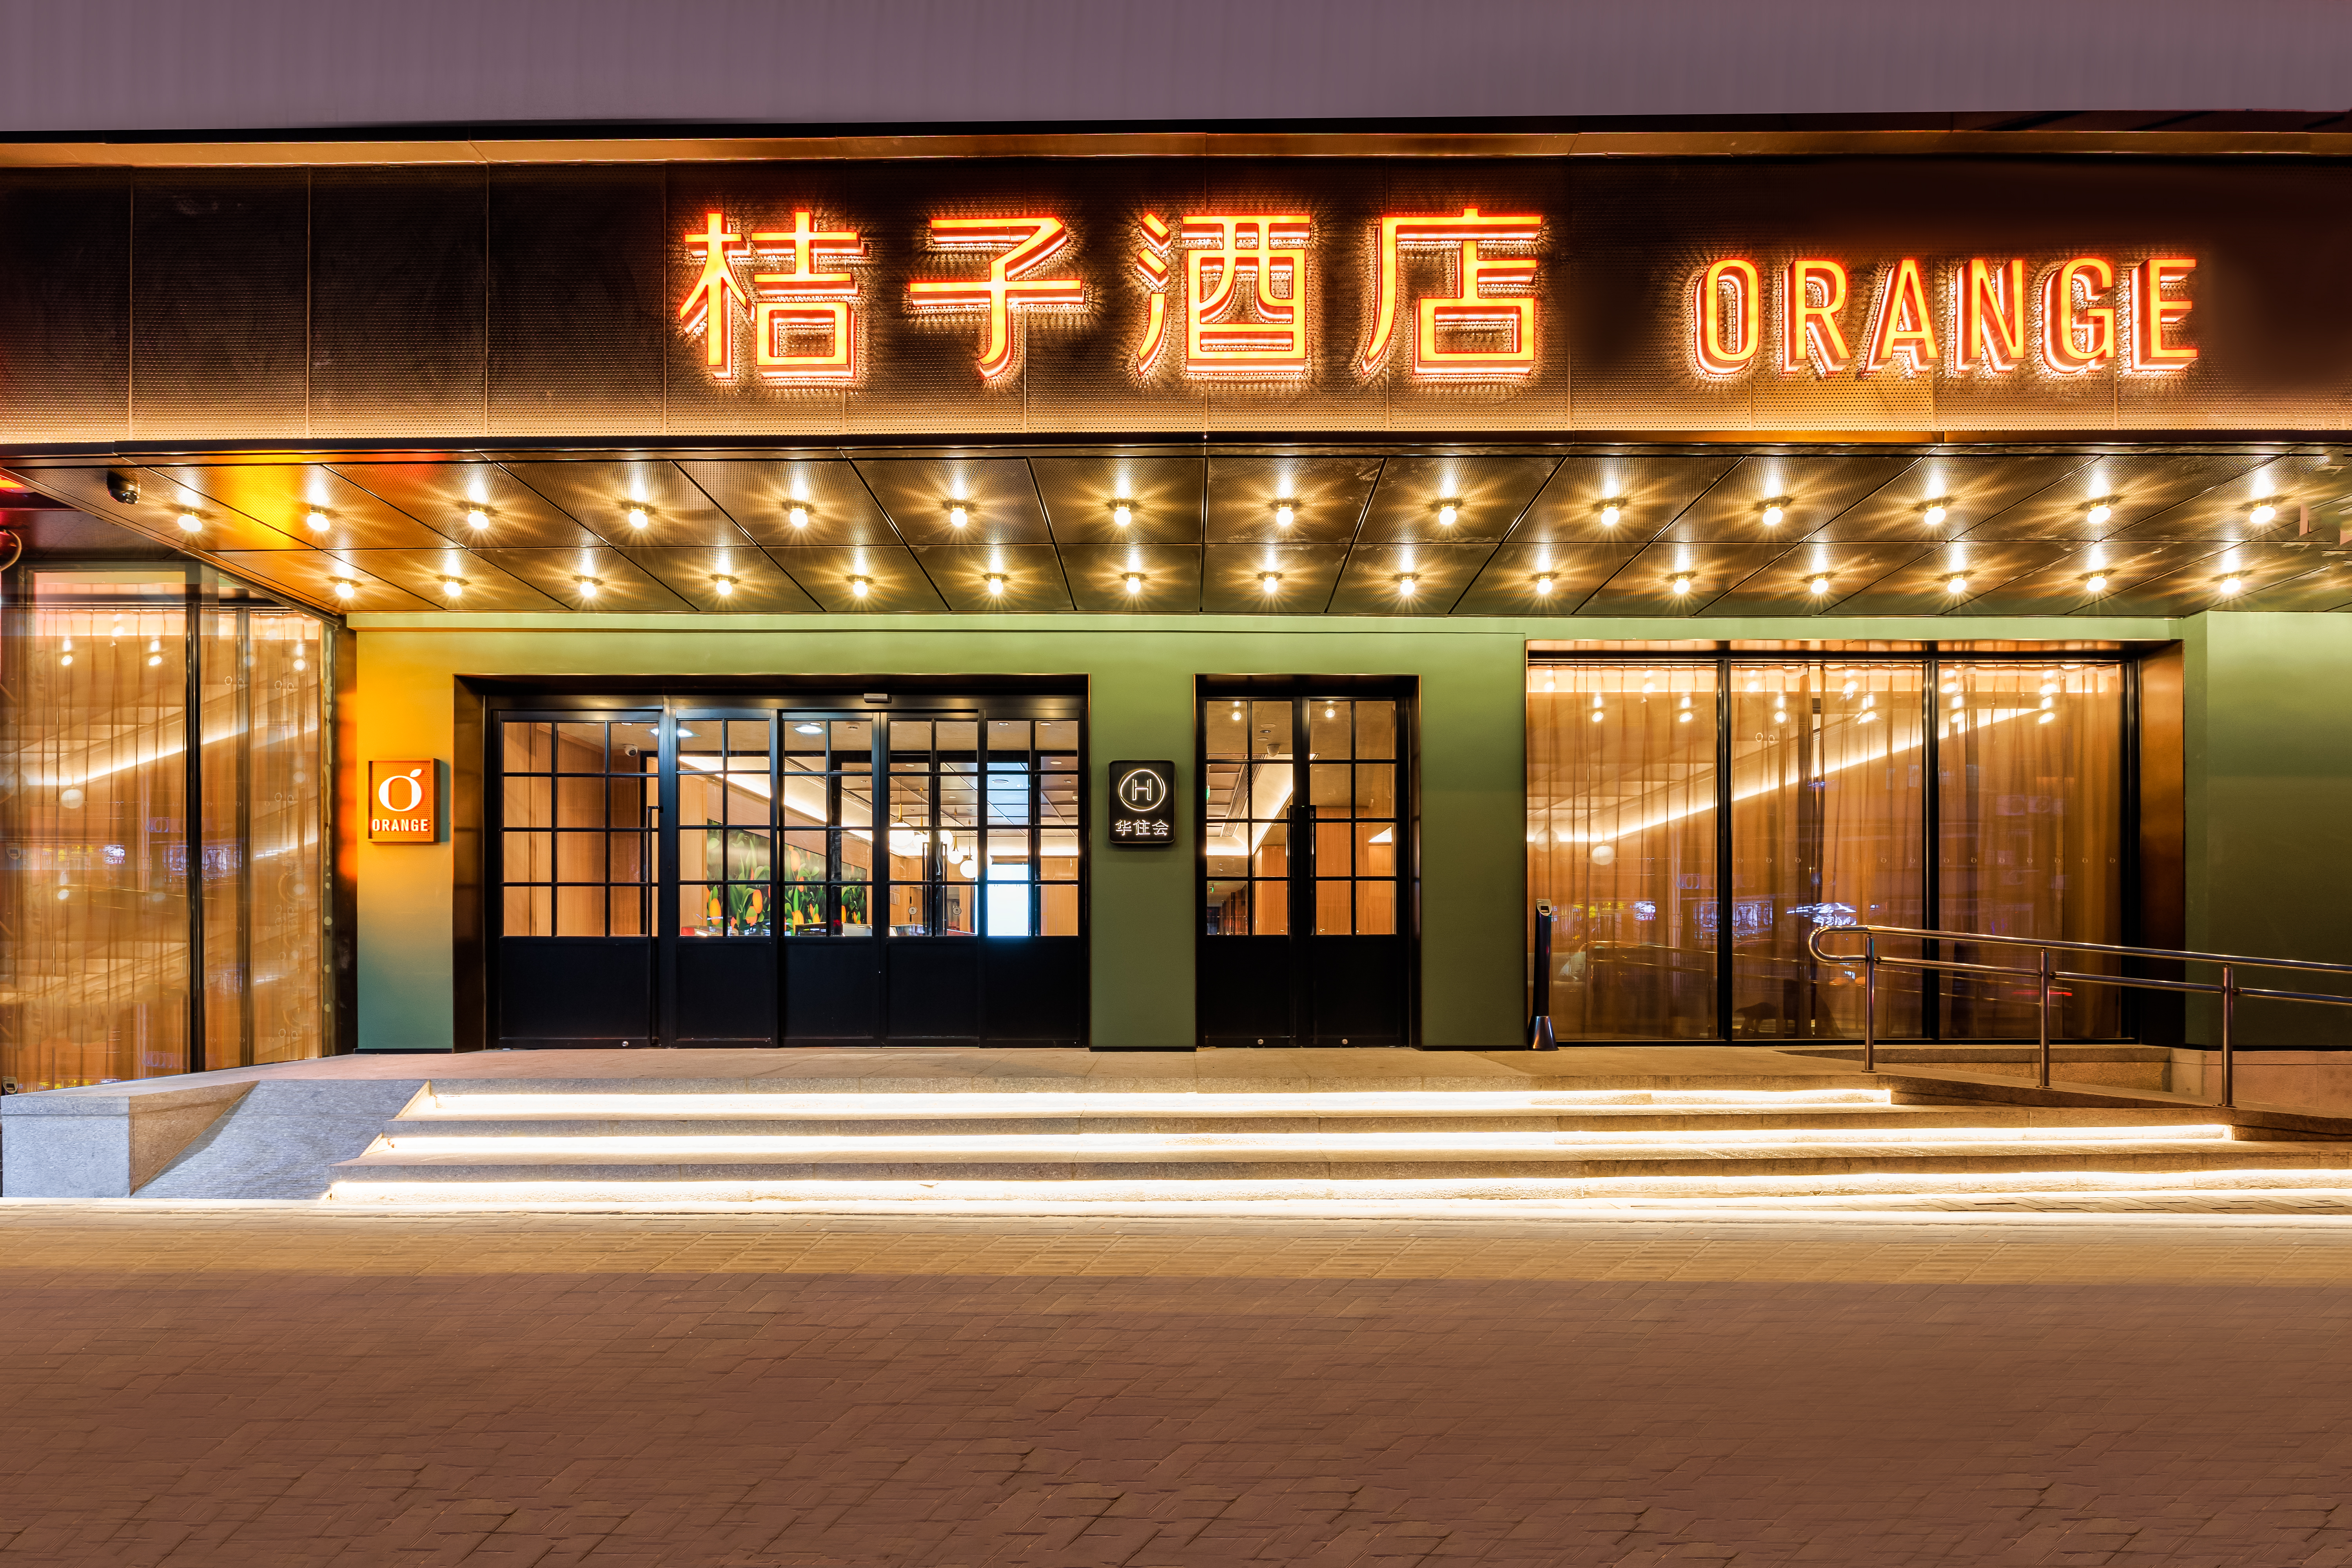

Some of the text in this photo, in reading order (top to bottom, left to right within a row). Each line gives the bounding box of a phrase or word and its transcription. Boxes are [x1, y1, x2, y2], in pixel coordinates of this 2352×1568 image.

[679, 208, 1543, 379] 桔子酒店
[1696, 257, 2198, 367] ORANGE
[1132, 779, 1152, 800] H
[372, 818, 428, 831] ORANGE
[1115, 819, 1169, 836] 华住会
